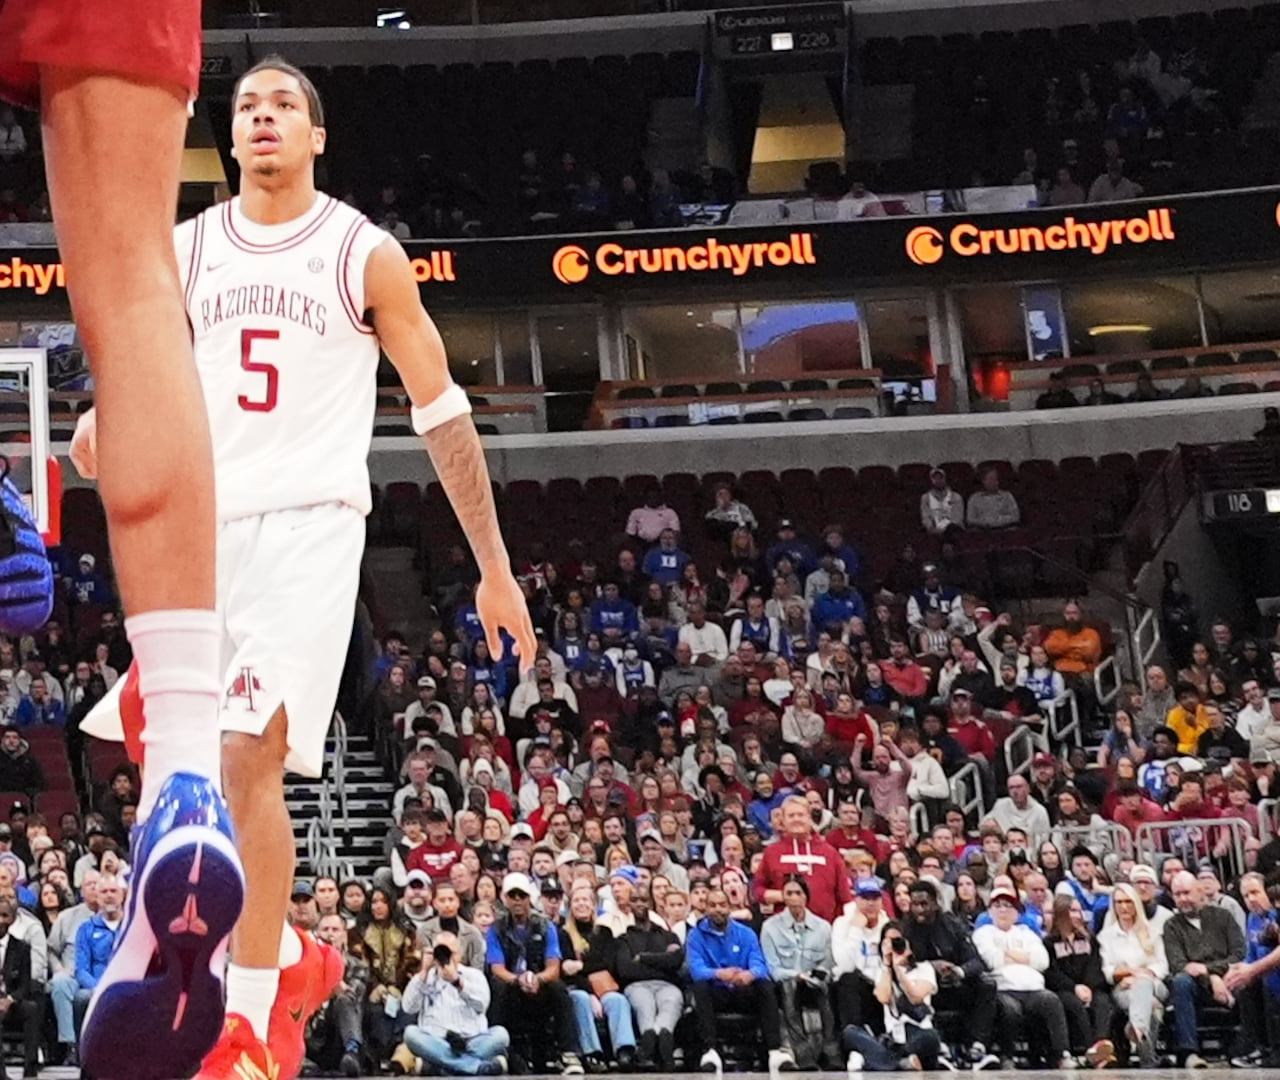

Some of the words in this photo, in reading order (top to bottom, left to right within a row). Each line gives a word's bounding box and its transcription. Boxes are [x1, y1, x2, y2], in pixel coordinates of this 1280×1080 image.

[596, 233, 815, 276] Crunchyroll
[950, 208, 1174, 256] Crunchyroll
[201, 285, 327, 336] RAZORBACKS
[238, 329, 280, 413] 5
